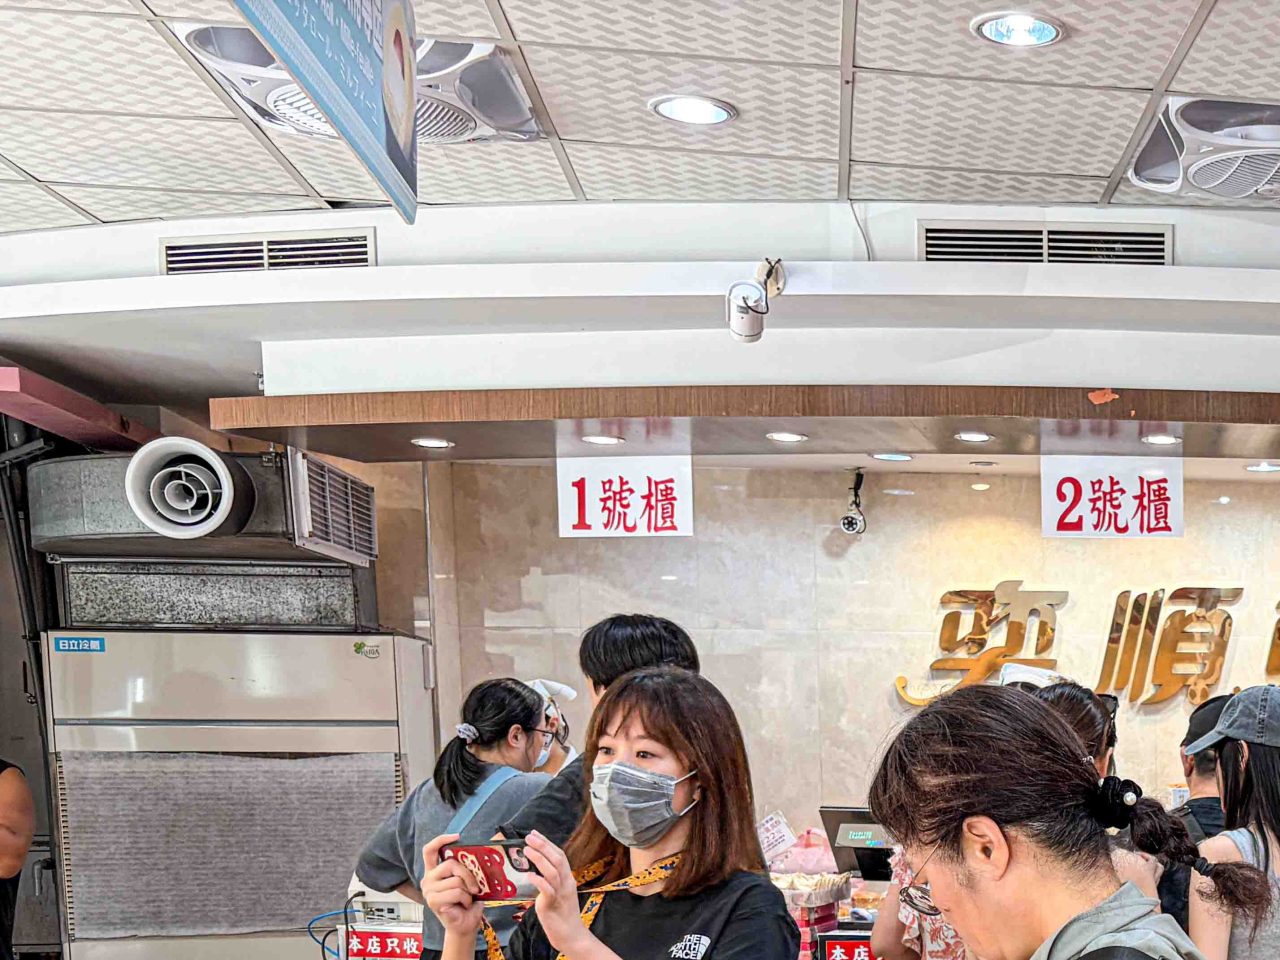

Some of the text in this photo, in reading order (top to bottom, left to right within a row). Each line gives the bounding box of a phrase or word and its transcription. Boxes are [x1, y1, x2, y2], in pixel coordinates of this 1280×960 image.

[571, 475, 678, 533] 1號櫃
[1056, 475, 1173, 534] 2號櫃
[349, 935, 421, 954] 本店只收
[684, 934, 701, 944] THE
[671, 950, 699, 960] FACE
